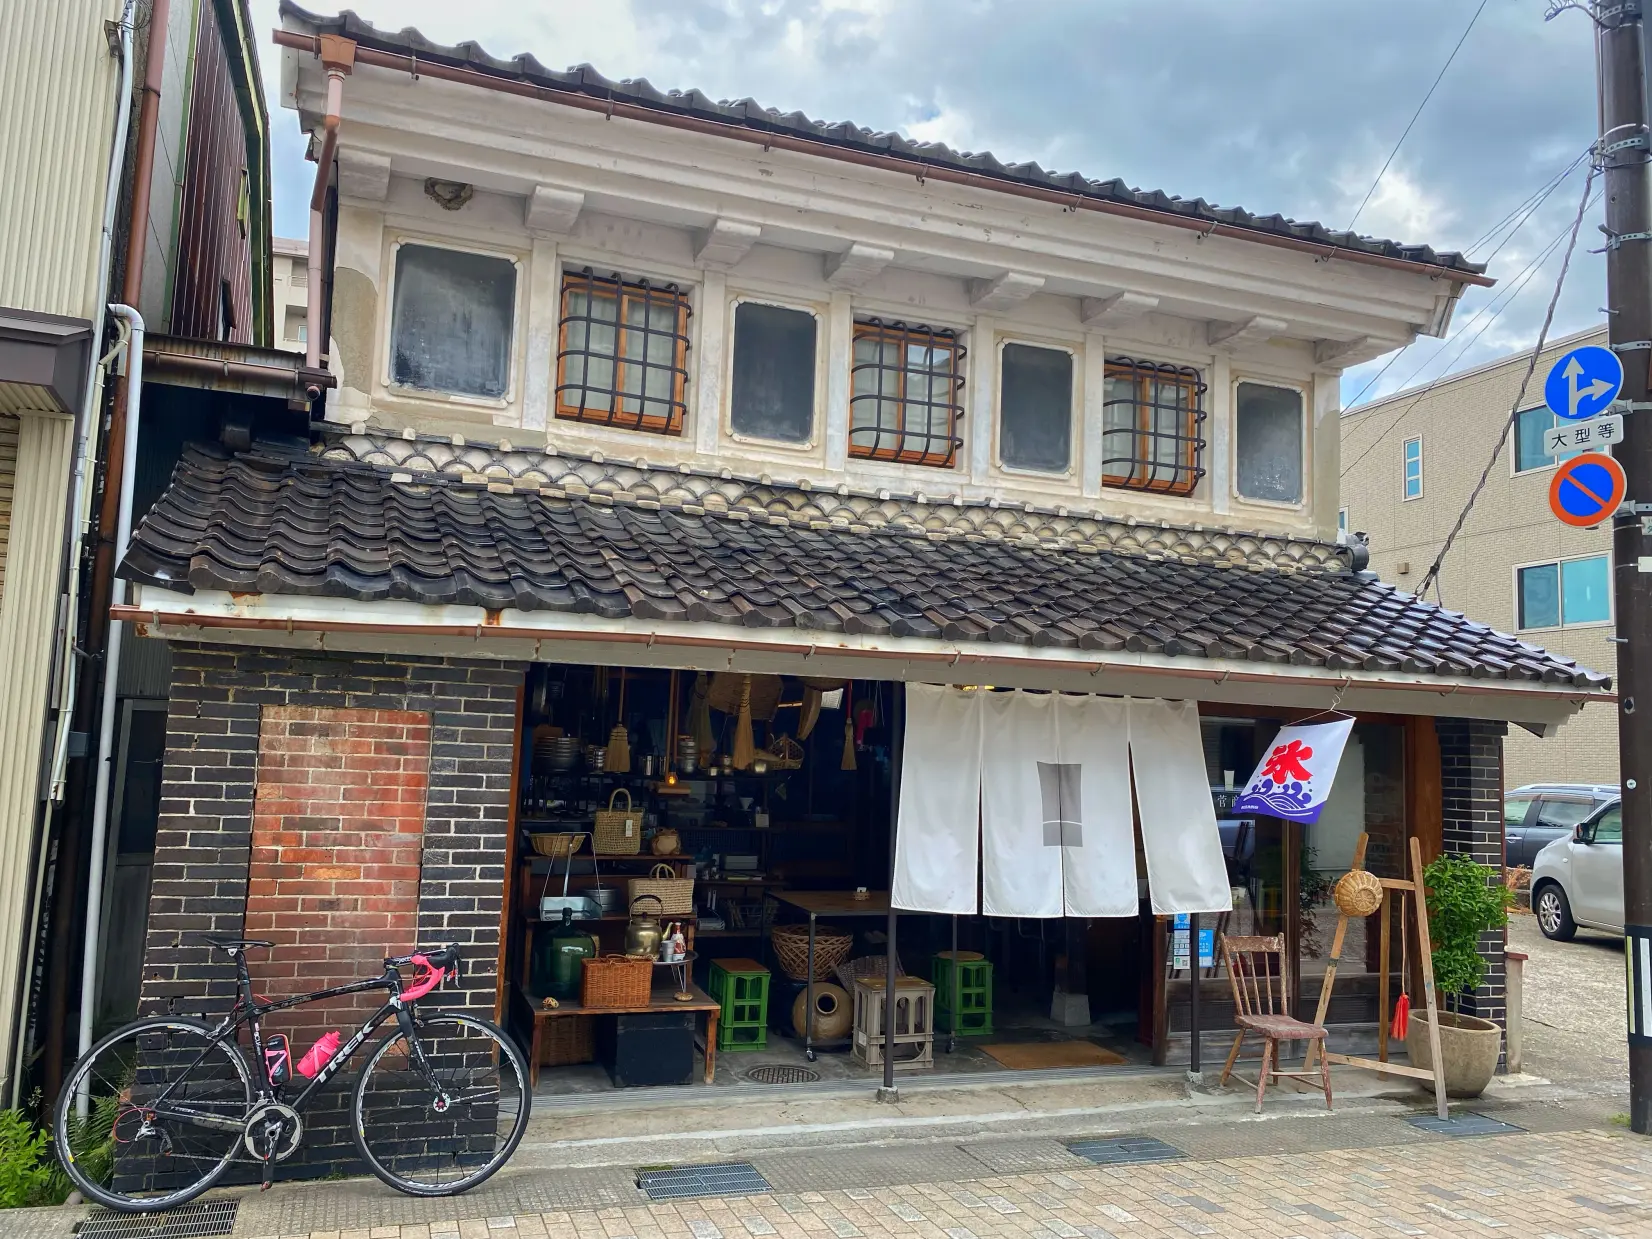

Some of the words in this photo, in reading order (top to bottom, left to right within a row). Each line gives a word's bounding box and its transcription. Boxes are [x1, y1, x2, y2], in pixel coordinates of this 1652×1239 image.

[1552, 423, 1614, 449] 大型等
[1261, 739, 1313, 784] 氷
[313, 1020, 374, 1084] TREK
